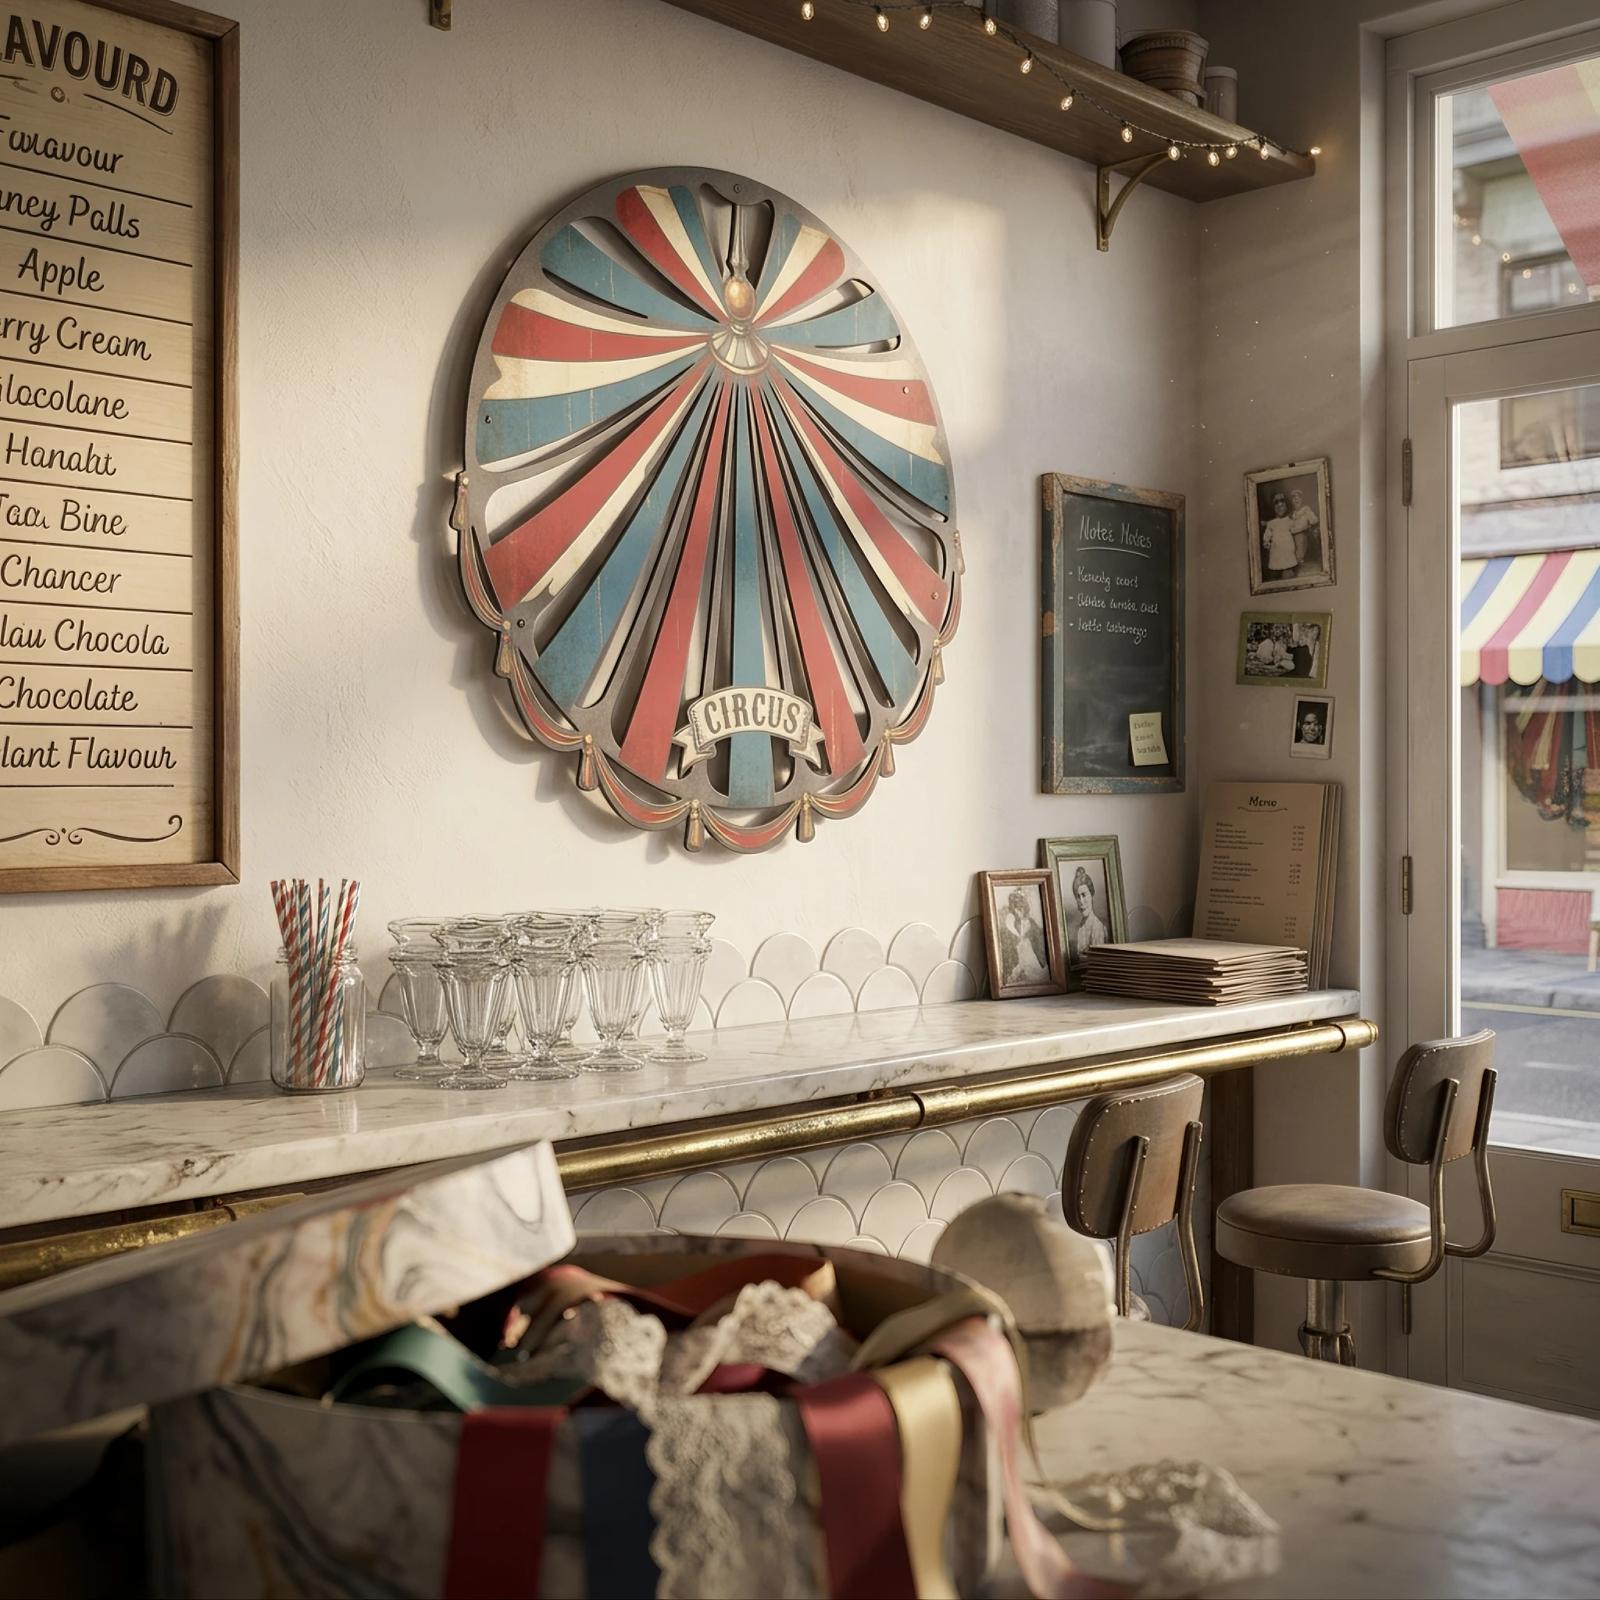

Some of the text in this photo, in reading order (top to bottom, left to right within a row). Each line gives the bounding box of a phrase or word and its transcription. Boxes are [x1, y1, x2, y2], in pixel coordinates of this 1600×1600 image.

[0, 15, 179, 116] AVOURD
[0, 190, 140, 238] ney Palls
[18, 248, 104, 295] Apple
[0, 316, 152, 361] rry Cream
[60, 499, 127, 535] Bine
[0, 554, 122, 593] Chancer
[54, 618, 170, 655] Chocola
[0, 676, 138, 711] Chocolate
[703, 692, 801, 734] CIRCUS
[1, 736, 60, 768] lant
